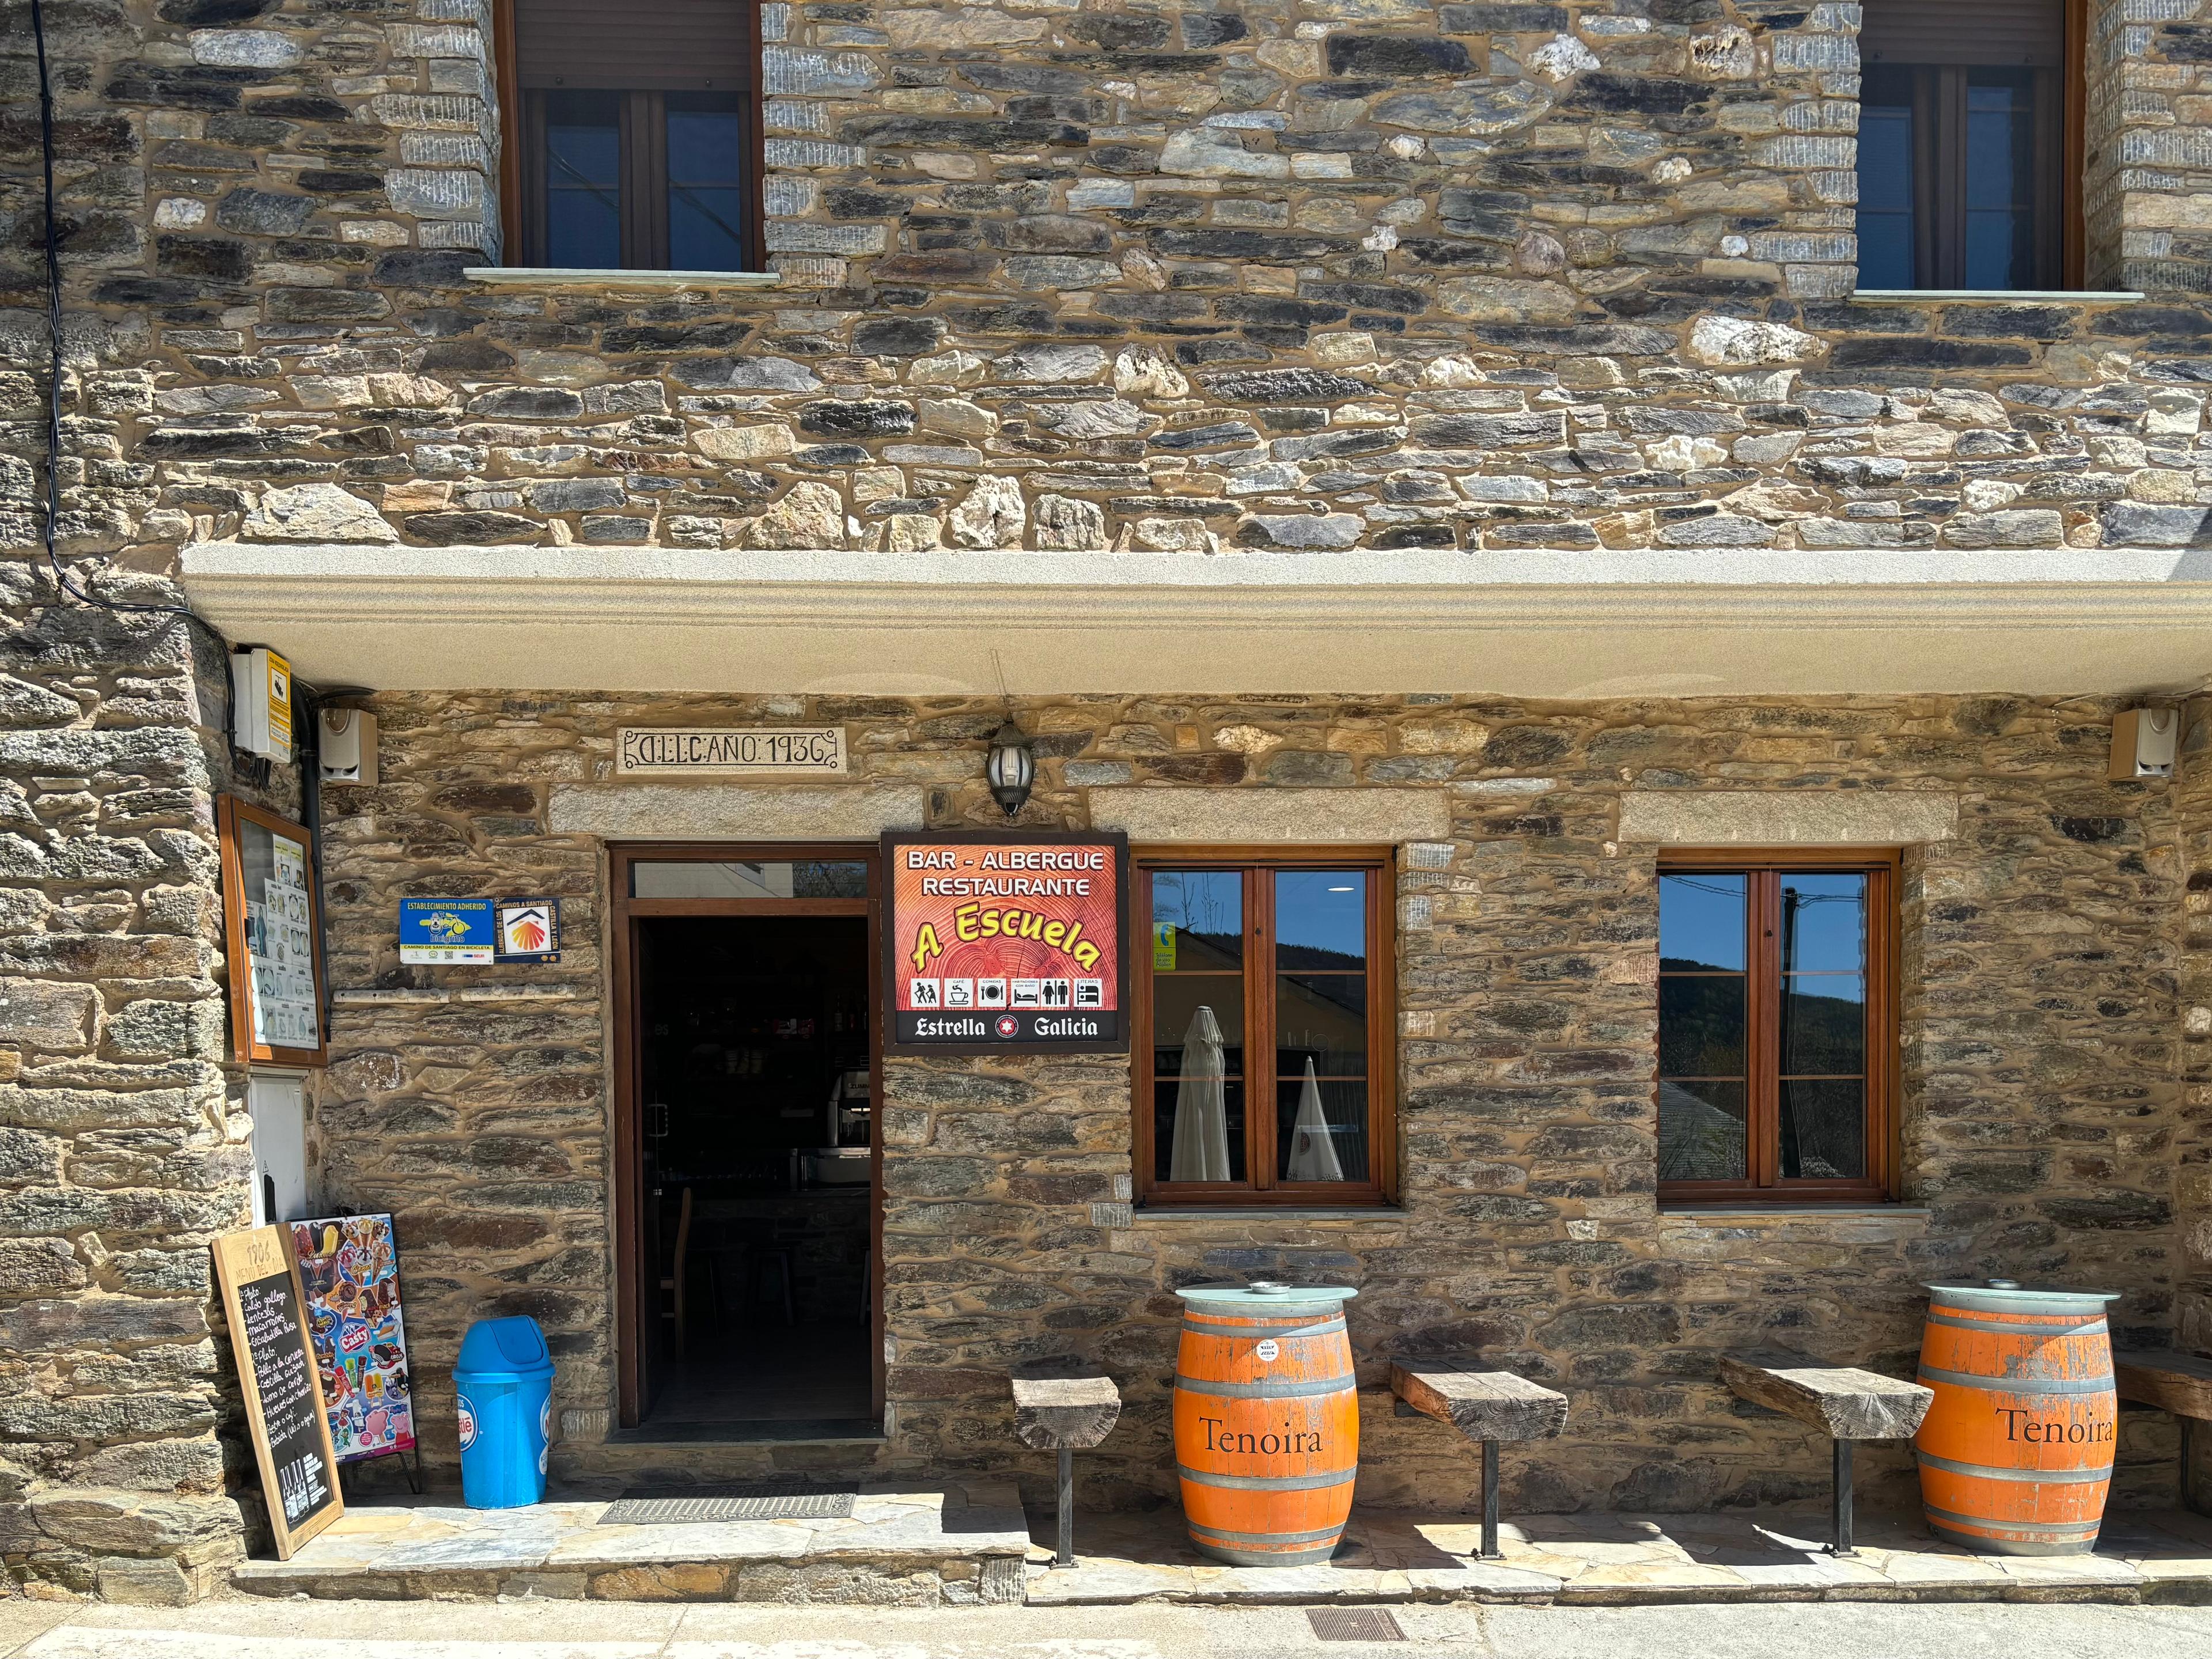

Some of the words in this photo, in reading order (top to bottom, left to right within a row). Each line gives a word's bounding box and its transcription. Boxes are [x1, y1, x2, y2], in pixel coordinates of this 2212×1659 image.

[908, 851, 956, 870] BAR
[980, 852, 1104, 870] ALBERGUE
[922, 877, 1090, 896] RESTAURANTE
[407, 902, 456, 910] ESTABLECIMIENTO
[910, 922, 945, 974] A
[954, 901, 1103, 973] Escuela
[915, 1017, 986, 1036] Estrella
[1034, 1017, 1099, 1036] Galicia
[247, 1240, 271, 1266] 1906
[340, 1329, 369, 1349] Casty
[1199, 1416, 1324, 1455] Tenoira
[1995, 1407, 2113, 1444] Tenoira
